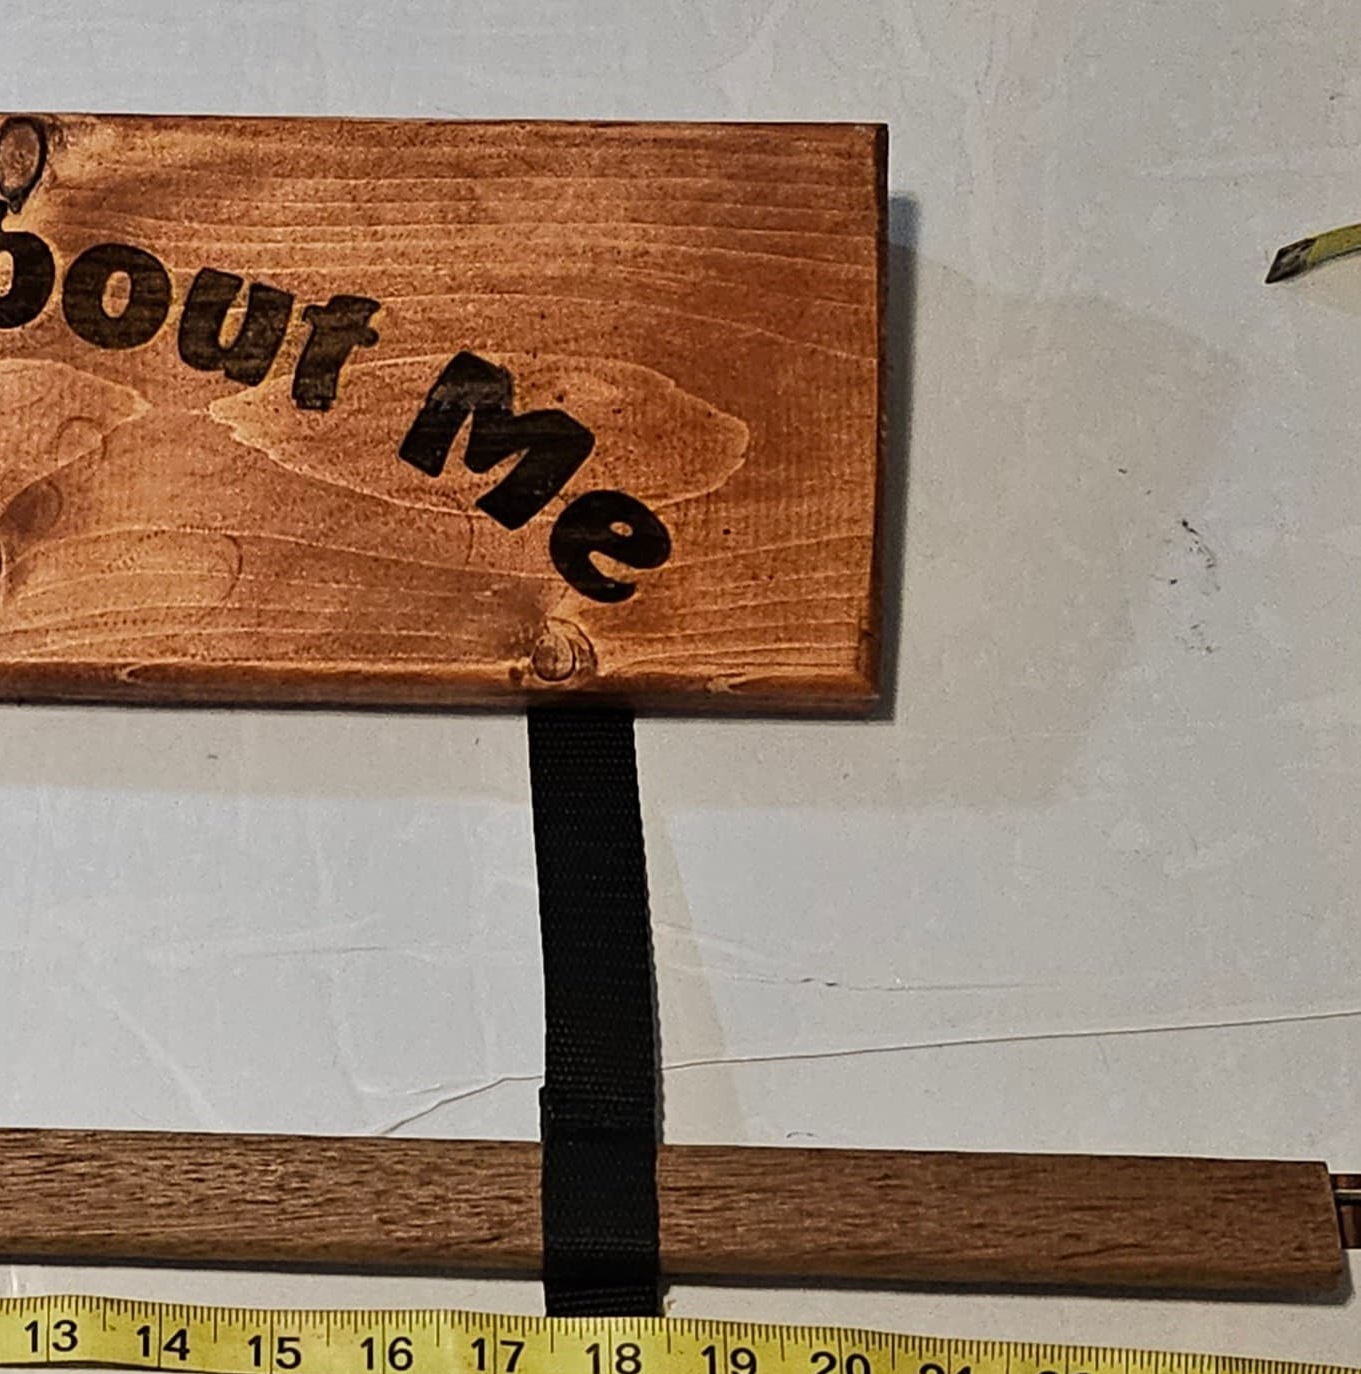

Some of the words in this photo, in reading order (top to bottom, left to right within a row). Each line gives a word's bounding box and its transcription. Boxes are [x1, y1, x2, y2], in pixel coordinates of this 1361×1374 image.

[398, 349, 675, 602] Me
[25, 1318, 78, 1353] 13
[137, 1324, 191, 1361] 14
[248, 1335, 302, 1369] 15
[361, 1337, 413, 1371] 16
[472, 1336, 525, 1373] 17
